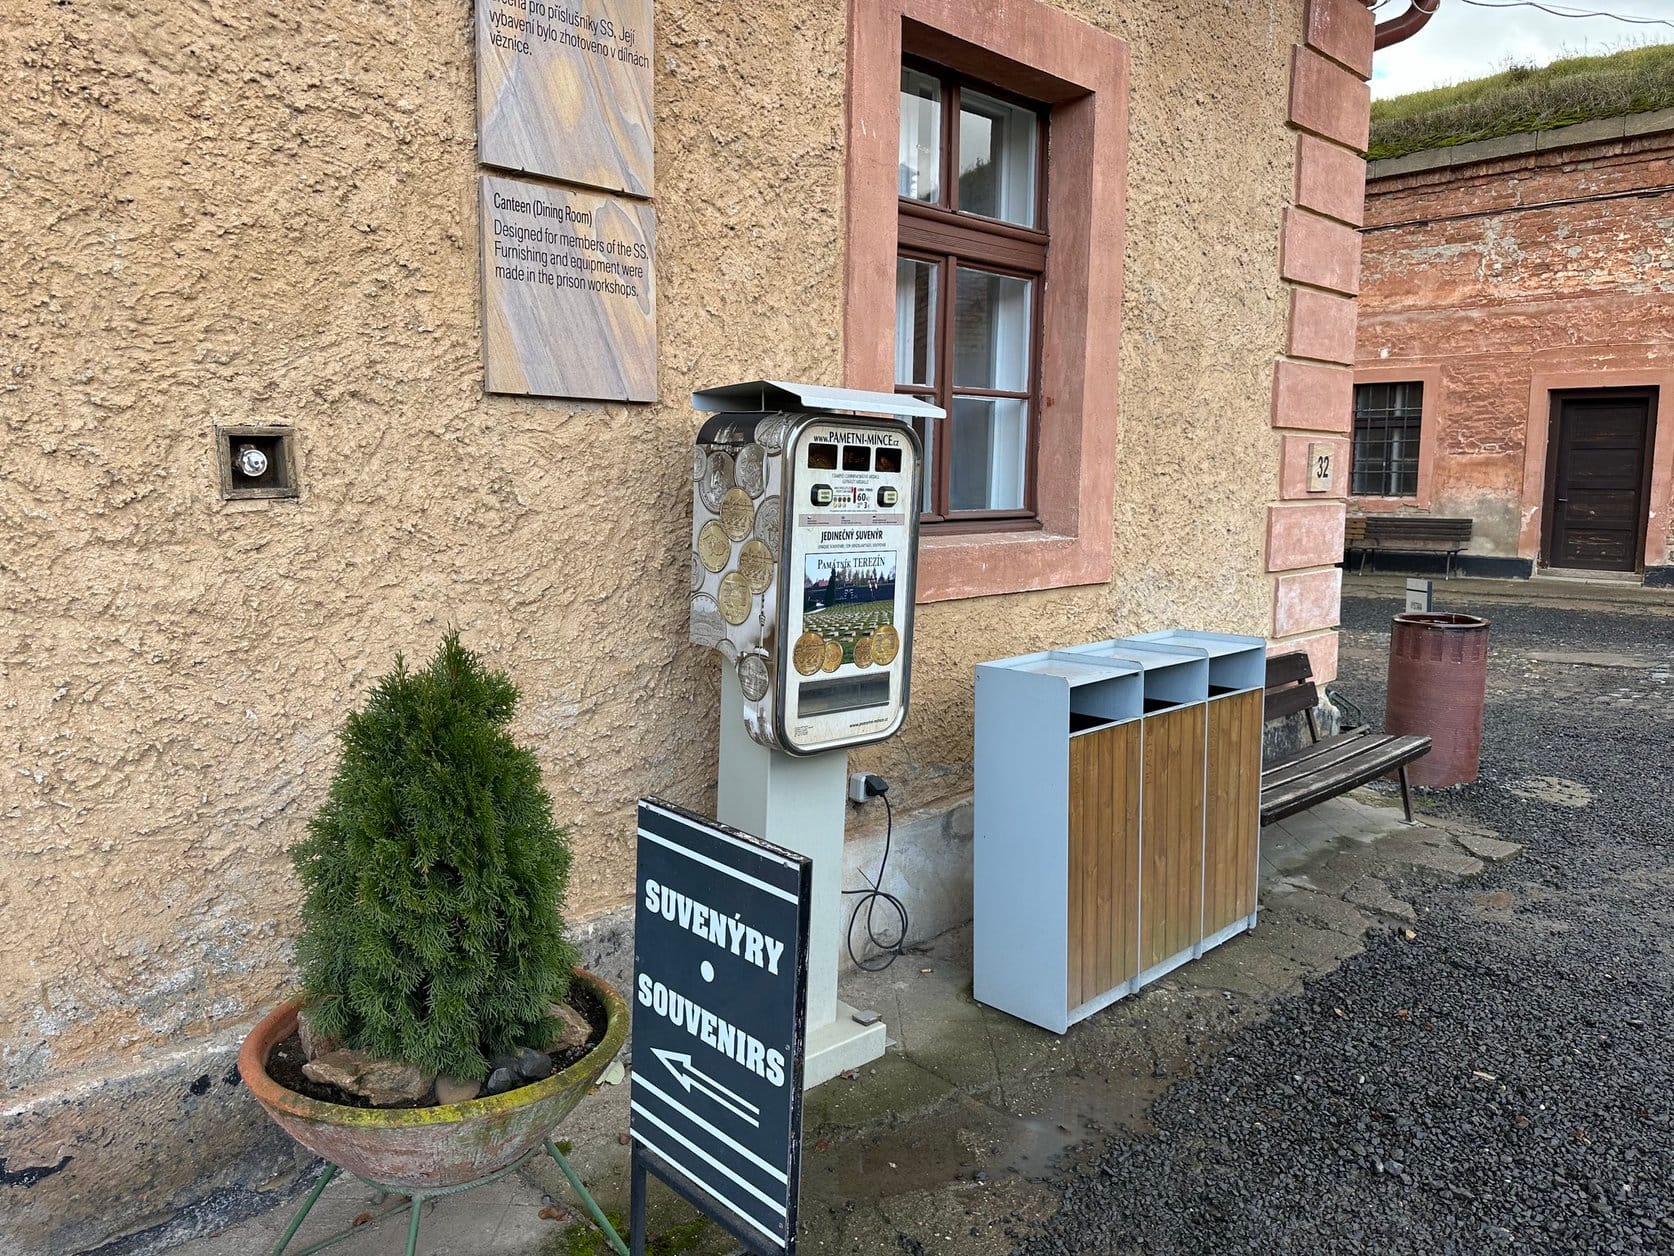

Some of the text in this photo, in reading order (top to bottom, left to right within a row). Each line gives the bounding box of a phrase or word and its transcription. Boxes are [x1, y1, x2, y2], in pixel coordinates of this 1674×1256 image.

[489, 9, 650, 69] vybavení bylo zhotoveno v dílnách
[529, 1, 546, 16] pro
[548, 5, 598, 36] příslušníky
[600, 19, 616, 39] SS.
[619, 26, 636, 48] Její
[489, 30, 532, 56] věznice.
[493, 192, 592, 227] Canteen (Dining Room)
[494, 219, 649, 260] Designed for members of the SS.
[494, 241, 643, 279] Furnishing and equipment were
[495, 265, 639, 299] made in the prison workshops.
[1317, 455, 1330, 479] 32
[857, 493, 867, 502] 60
[820, 528, 884, 543] JEDINEČNÝ SUVENÝR
[853, 554, 886, 568] TEREZÍN
[644, 877, 786, 976] SUVENÝRY
[637, 971, 786, 1088] SOUVENIRS
